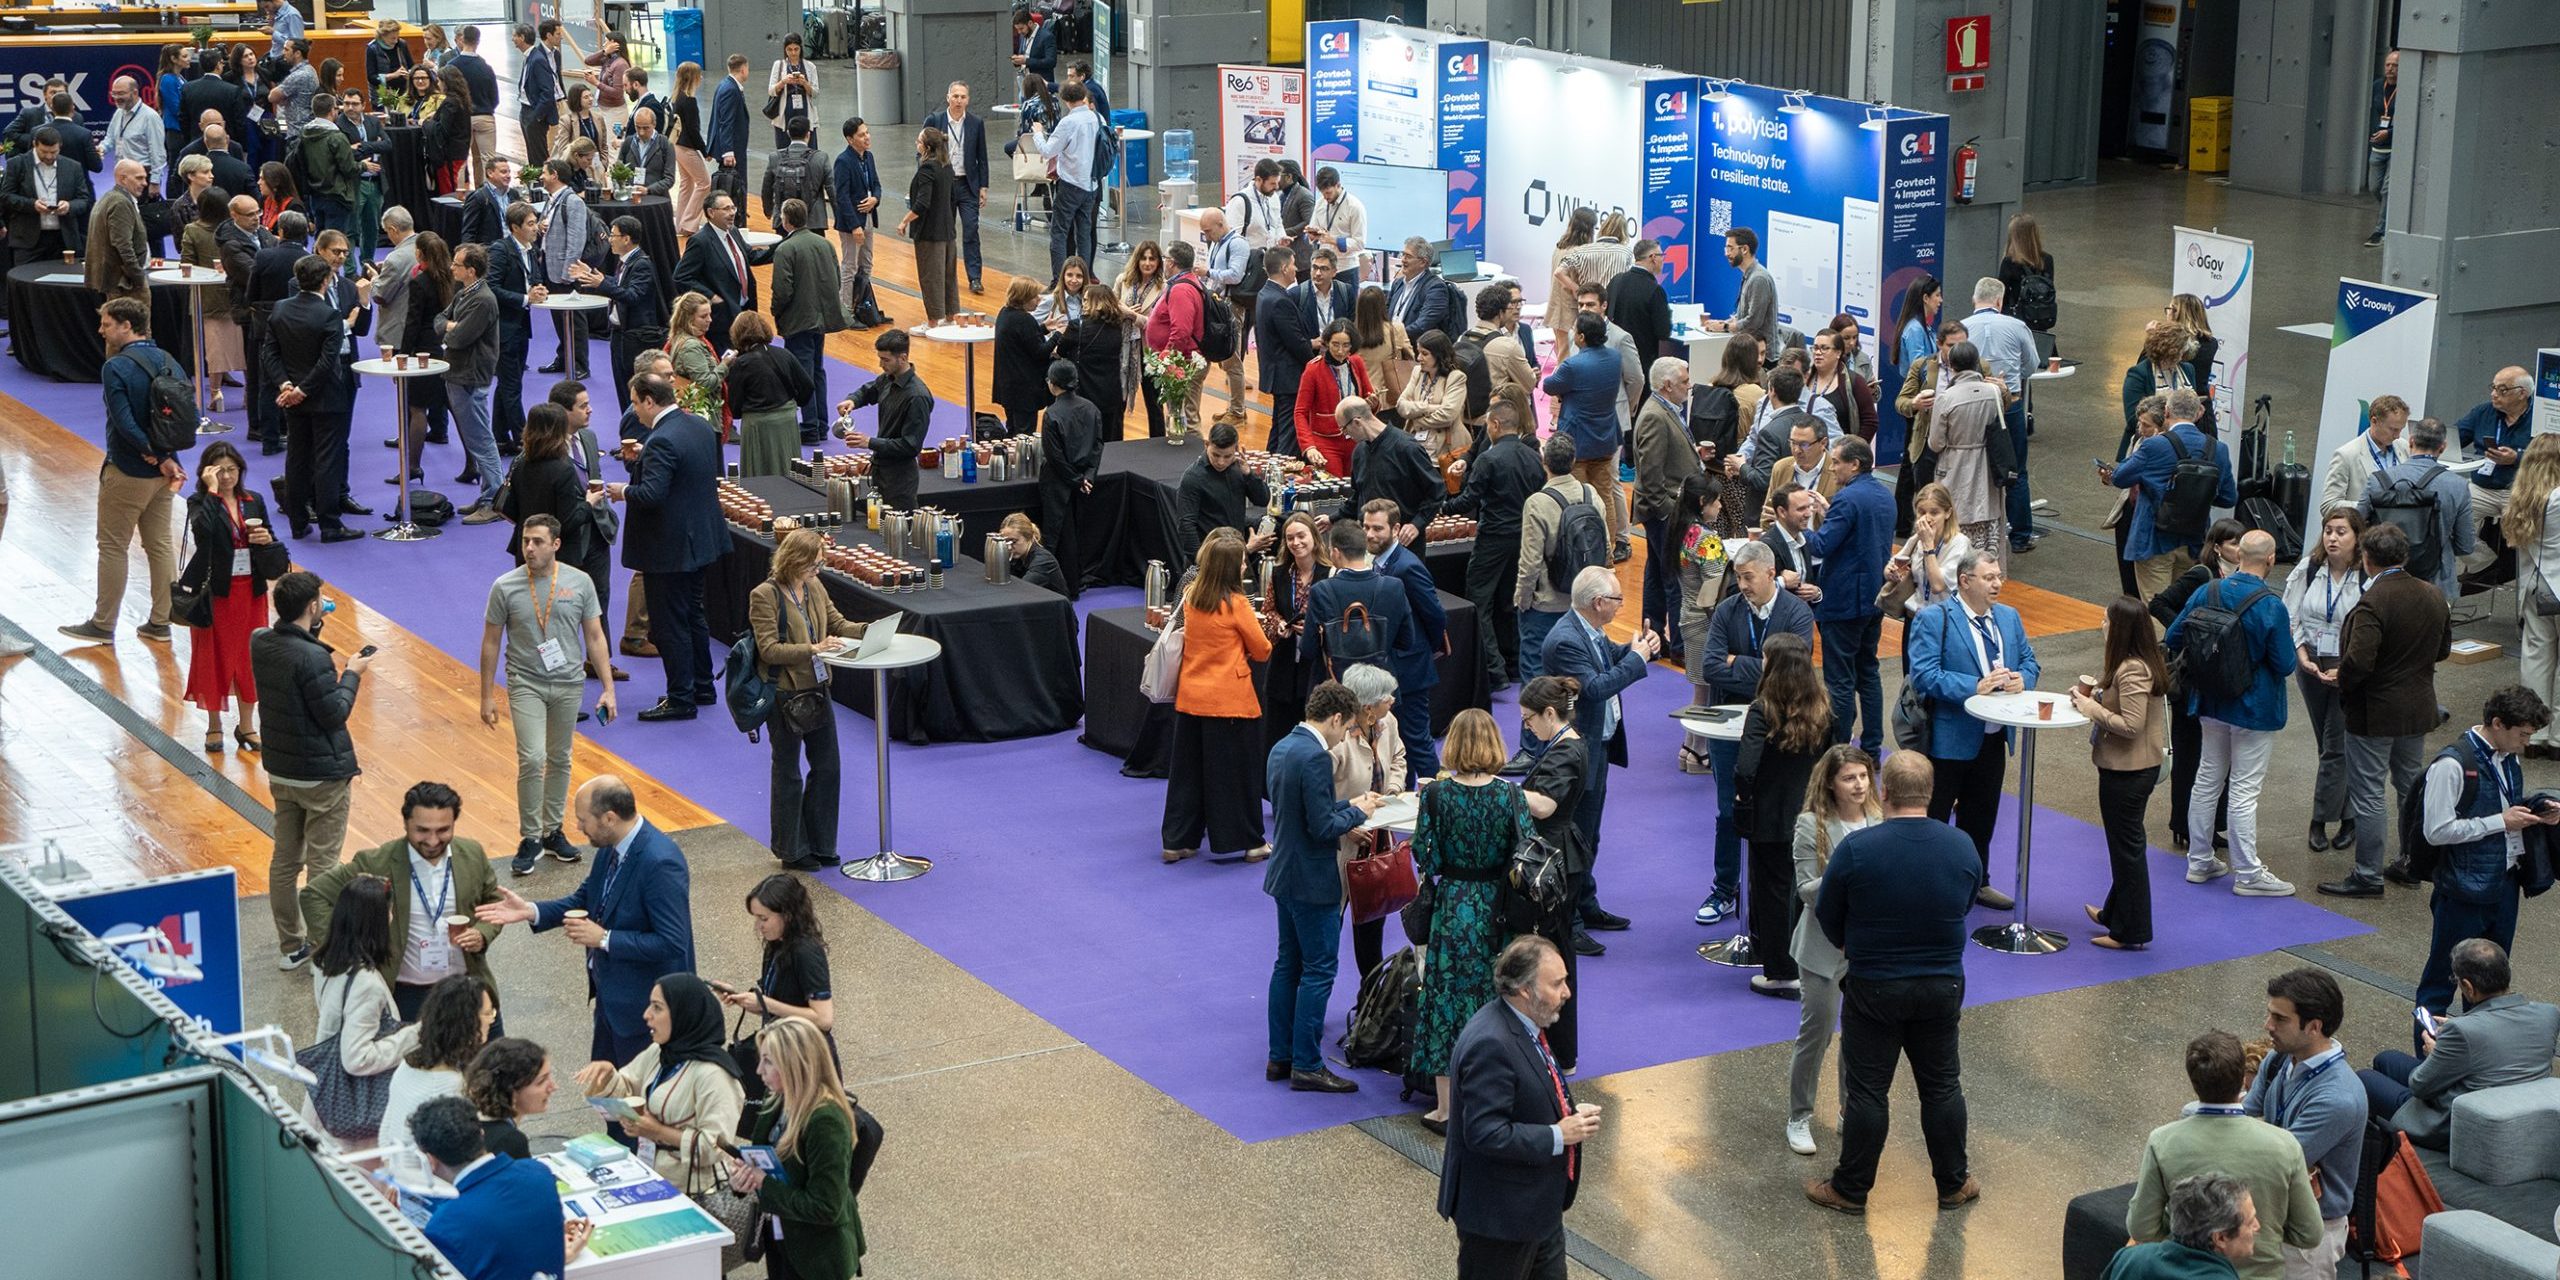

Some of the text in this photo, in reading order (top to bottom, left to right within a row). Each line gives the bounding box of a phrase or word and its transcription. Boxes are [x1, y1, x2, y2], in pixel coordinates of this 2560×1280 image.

[1320, 32, 1350, 52] G4I
[1448, 54, 1479, 75] G4I
[1323, 79, 1352, 89] Impact
[1450, 102, 1480, 113] Impact
[1655, 91, 1687, 114] G4I
[1727, 111, 1788, 141] polyteia
[1336, 129, 1352, 137] 2024
[1657, 143, 1688, 155] Impact
[1901, 132, 1936, 156] G4I
[1464, 155, 1480, 163] 2024
[1712, 142, 1786, 170] Technology for
[1711, 168, 1791, 194] a resilient state.
[1894, 188, 1935, 200] 4 Impact
[1671, 199, 1688, 208] 2024
[1894, 203, 1910, 211] World
[1916, 248, 1935, 258] 2024
[2210, 271, 2222, 281] Tech
